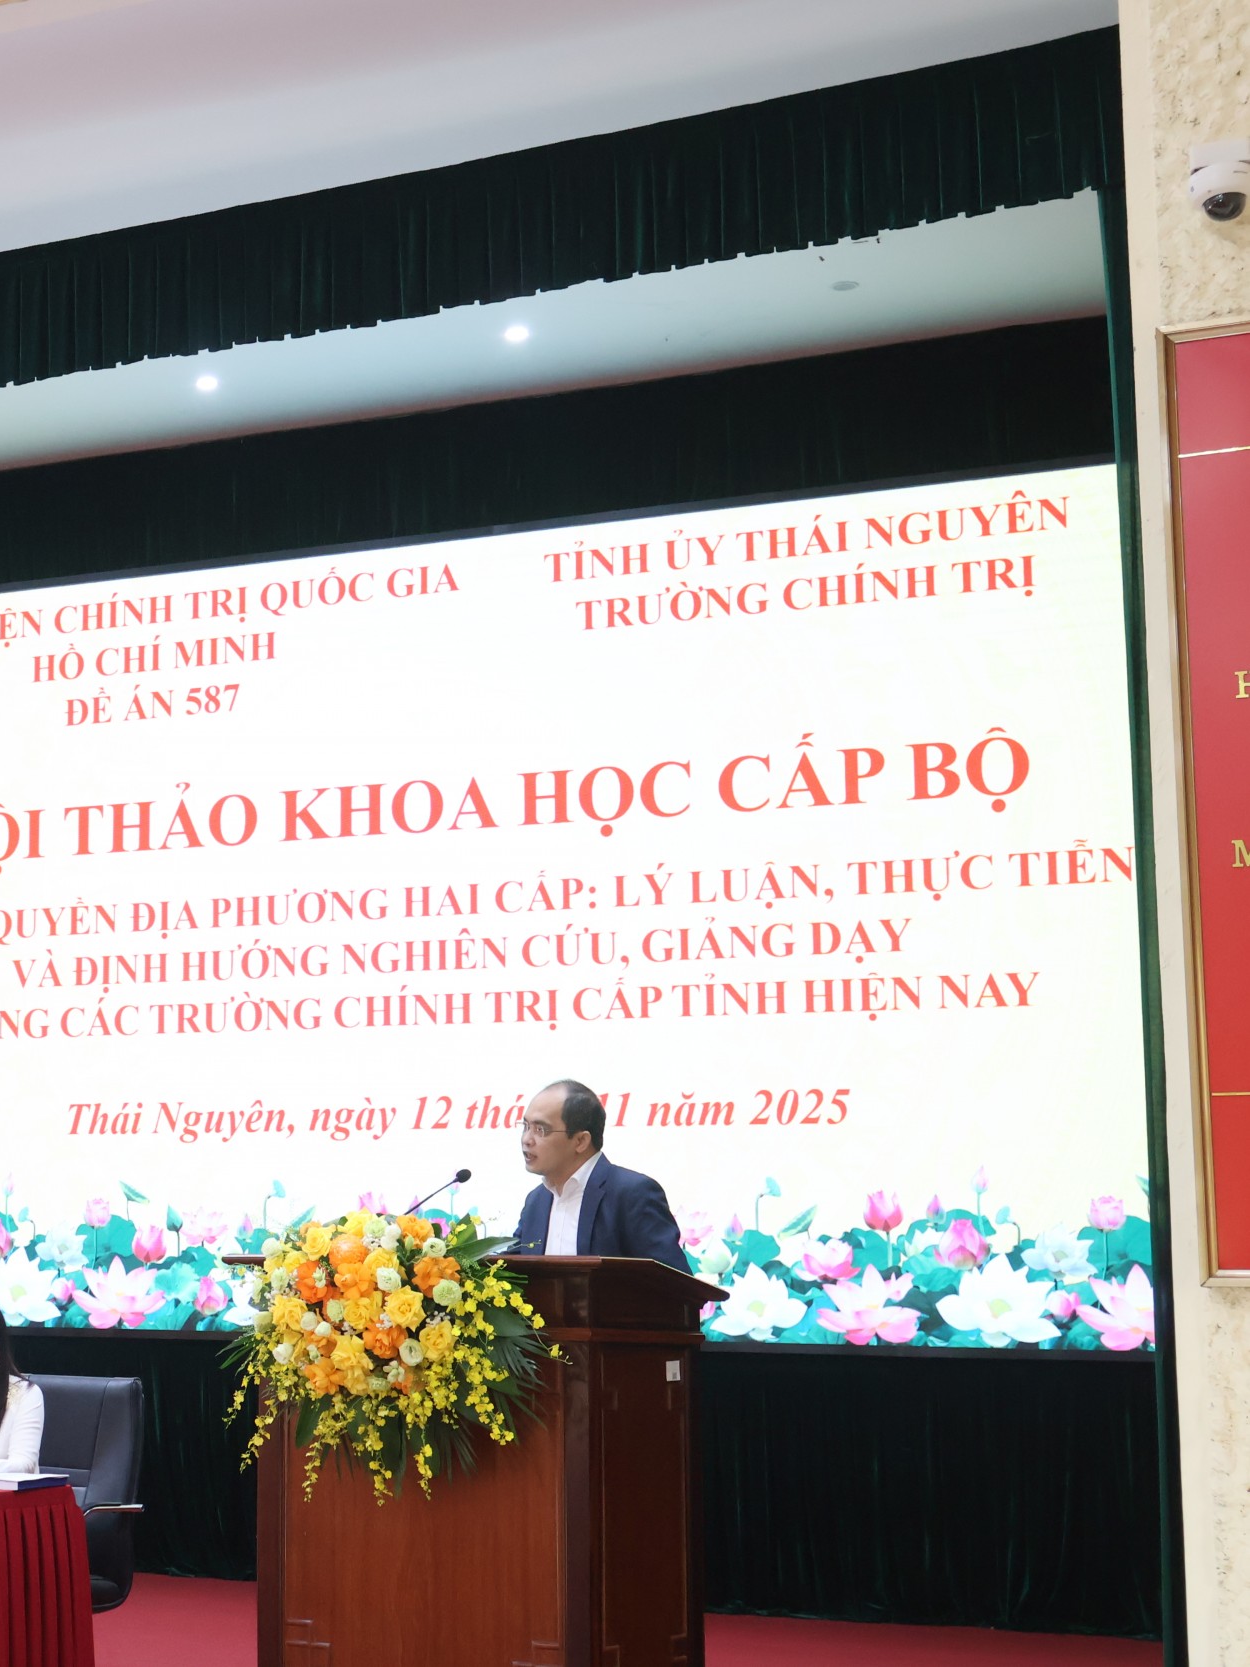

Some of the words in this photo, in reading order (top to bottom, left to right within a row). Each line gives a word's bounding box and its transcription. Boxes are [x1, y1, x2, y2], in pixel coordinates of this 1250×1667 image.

[543, 540, 651, 583] TỈNH
[665, 528, 725, 571] ỦY
[735, 513, 848, 563] THÁI
[864, 489, 1070, 550] NGUYÊN
[53, 591, 173, 635] CHÍNH
[184, 586, 248, 624] TRỊ
[259, 566, 375, 617] QUỐC
[386, 563, 460, 599] GIA
[575, 580, 769, 631] TRƯỜNG
[782, 562, 938, 611] CHÍNH
[950, 554, 1035, 598] TRỊ
[33, 642, 85, 683] HỒ
[94, 643, 161, 677] CHÍ
[174, 631, 276, 669] MINH
[65, 686, 112, 727] ĐỀ
[124, 683, 174, 721] ÁN
[185, 683, 241, 716] 587
[63, 781, 258, 856] THẢO
[280, 776, 500, 842] KHOA
[517, 759, 692, 838] HỌC
[717, 732, 886, 813] CẤP
[905, 726, 1031, 814] BỘ
[131, 900, 199, 940] ĐỊA
[210, 887, 389, 929] PHƯƠNG
[404, 883, 479, 918] HAI
[494, 869, 597, 914] CẤP:
[614, 862, 674, 908] LÝ
[690, 861, 835, 910] LUẬN,
[846, 849, 993, 902] THỰC
[1007, 838, 1135, 888] TIỄN
[12, 948, 63, 989] VÀ
[74, 952, 168, 995] ĐỊNH
[181, 938, 329, 982] HƯỚNG
[341, 927, 508, 975] NGHIÊN
[521, 923, 630, 969] CỨU,
[641, 916, 796, 963] GIẢNG
[810, 917, 911, 965] DẠY
[59, 996, 140, 1038] CÁC
[149, 990, 322, 1035] TRƯỜNG
[333, 984, 472, 1029] CHÍNH
[483, 989, 559, 1032] TRỊ
[572, 976, 663, 1022] CẤP
[671, 972, 787, 1018] TỈNH
[803, 971, 922, 1022] HIỆN
[938, 971, 1039, 1010] NAY
[68, 1101, 144, 1136] Thái
[152, 1099, 295, 1144] Nguyên,
[308, 1096, 398, 1142] ngày
[412, 1095, 453, 1130] 12
[464, 1093, 526, 1130] thá
[645, 1091, 735, 1128] năm
[749, 1088, 851, 1126] 2025
